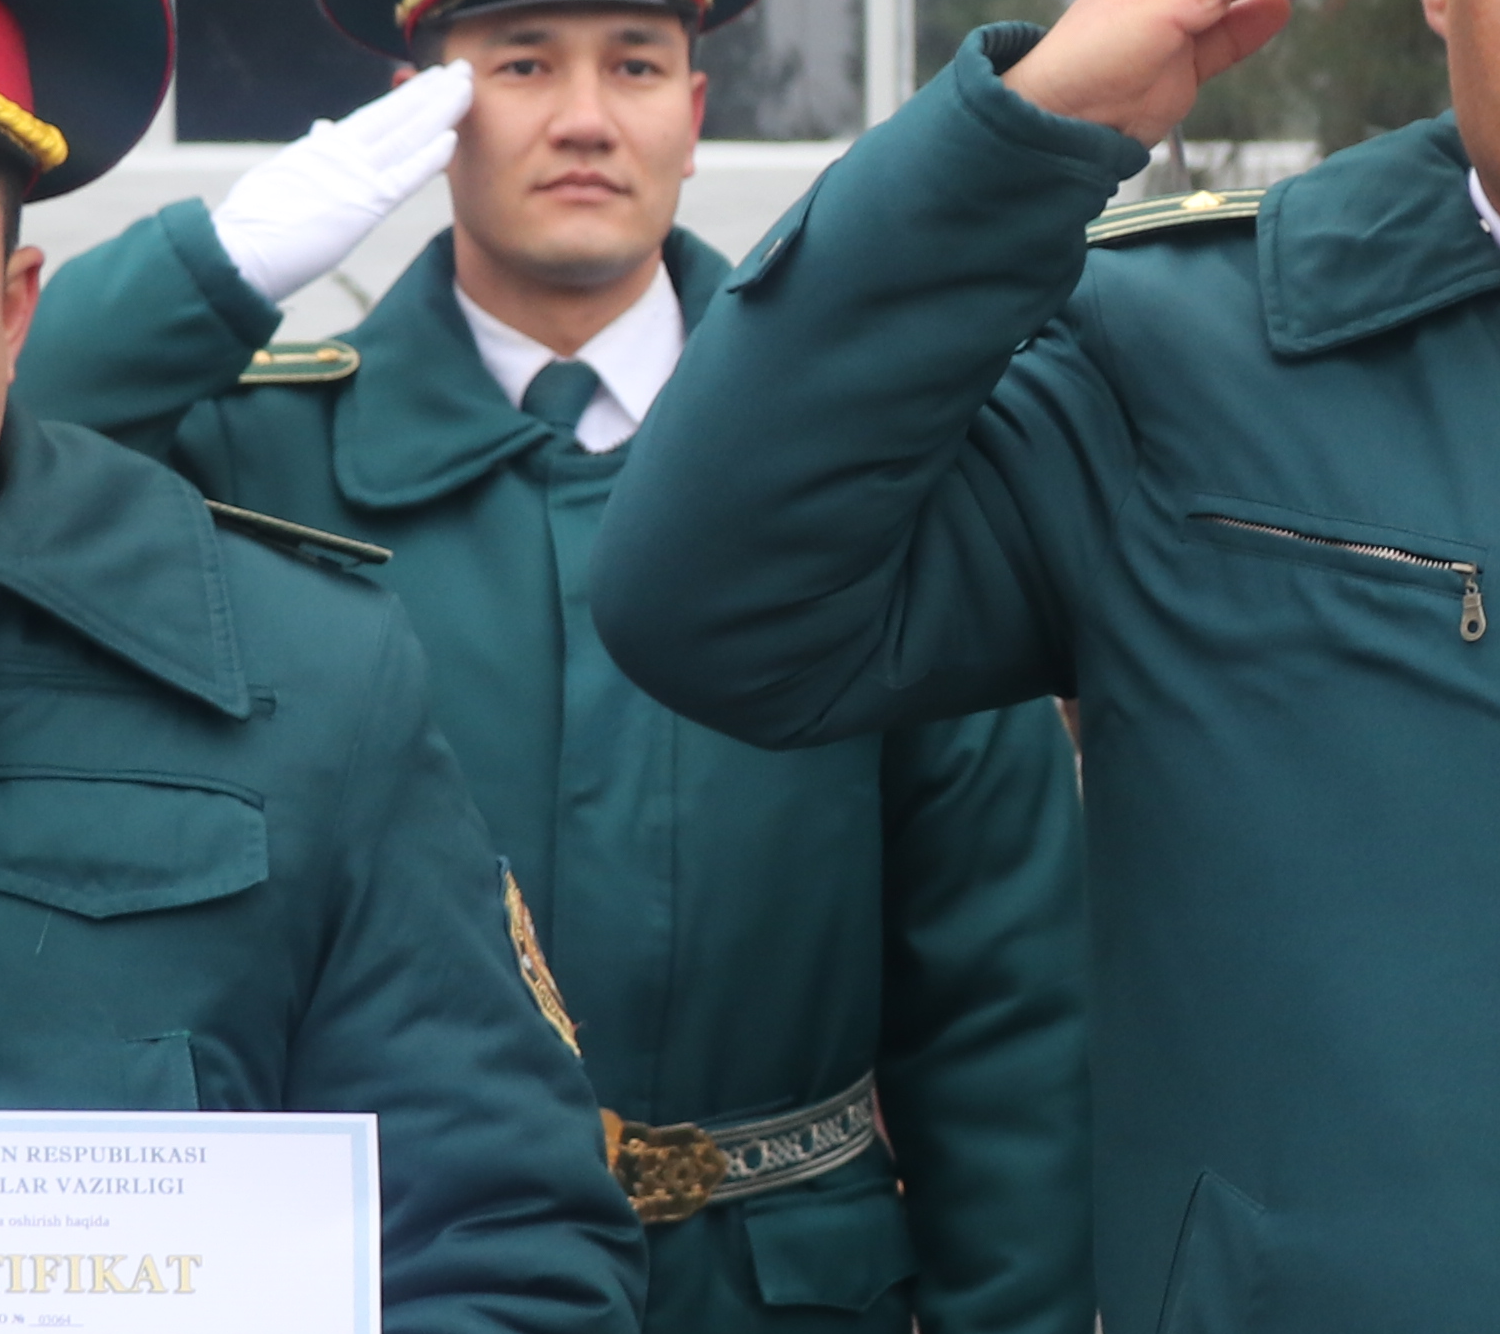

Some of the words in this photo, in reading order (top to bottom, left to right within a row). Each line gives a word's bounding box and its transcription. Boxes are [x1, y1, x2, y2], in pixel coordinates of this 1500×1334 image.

[27, 1146, 206, 1164] RESPUBLIKASI
[56, 1177, 183, 1195] VAZIRLIGI
[8, 1214, 61, 1228] oshirish
[66, 1215, 110, 1231] haqida
